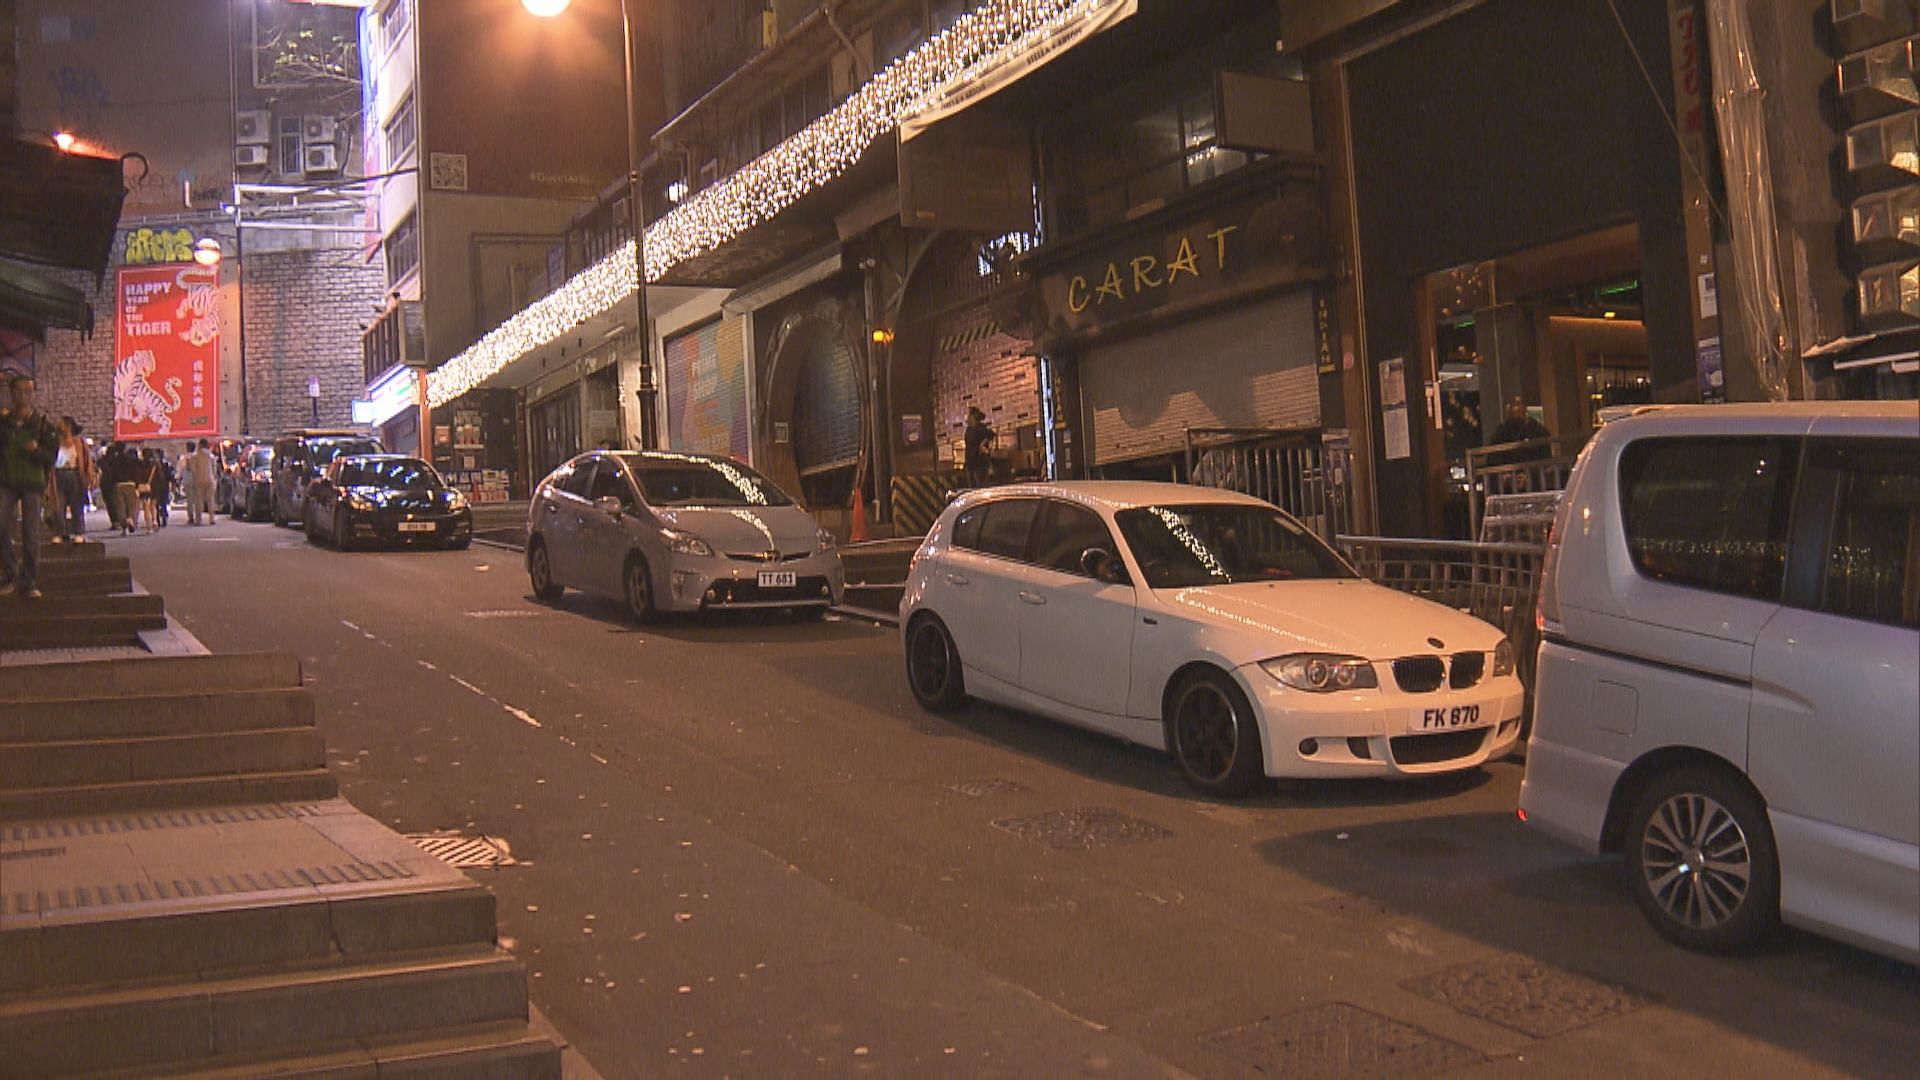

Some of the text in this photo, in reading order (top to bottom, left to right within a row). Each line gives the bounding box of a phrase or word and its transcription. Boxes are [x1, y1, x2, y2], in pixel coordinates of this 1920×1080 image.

[1069, 225, 1238, 313] CARAT
[125, 281, 172, 297] HAPPY
[126, 295, 149, 305] YEAR
[125, 305, 137, 313] OF
[125, 314, 144, 323] THE
[125, 321, 172, 337] TIGER
[761, 573, 774, 585] TT
[1423, 704, 1479, 728] FK 870
